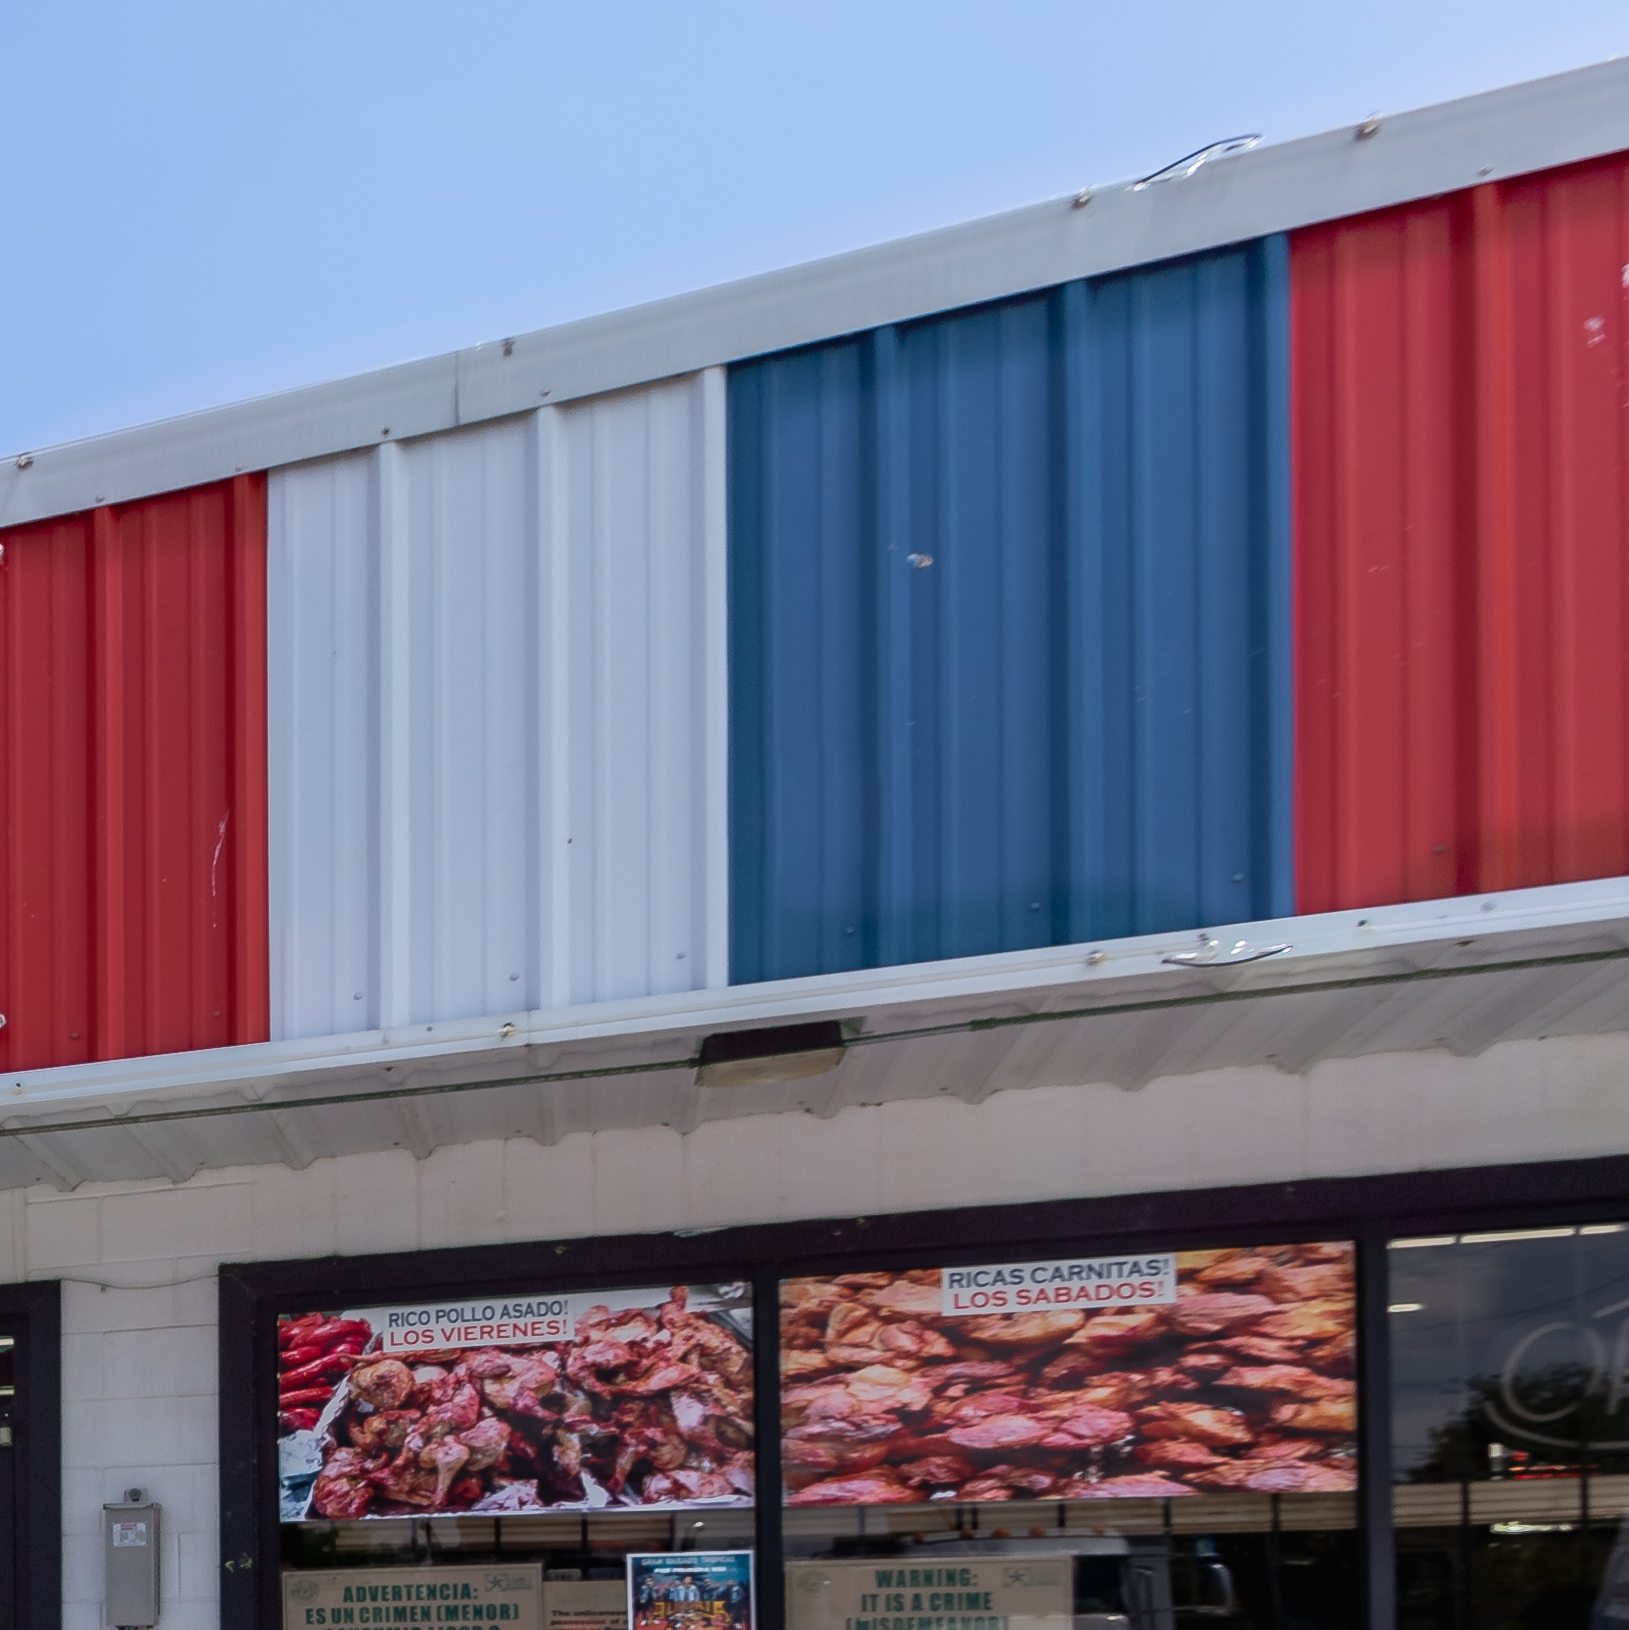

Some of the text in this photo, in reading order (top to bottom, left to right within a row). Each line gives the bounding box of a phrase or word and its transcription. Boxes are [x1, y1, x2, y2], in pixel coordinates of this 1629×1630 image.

[948, 1258, 1170, 1289] RICAS CARNITAS!
[953, 1280, 1164, 1310] LOS SABADOS!
[389, 1300, 568, 1328] RICO POLLO ASADO!
[390, 1319, 567, 1346] LOS VIERENES!
[875, 1568, 978, 1588] WARNING:
[342, 1583, 479, 1603] ADVERTENCIA:
[860, 1592, 993, 1612] IT IS A CRIME
[305, 1608, 326, 1625] ES
[331, 1606, 354, 1624] UN
[358, 1605, 432, 1624] CRIMEN
